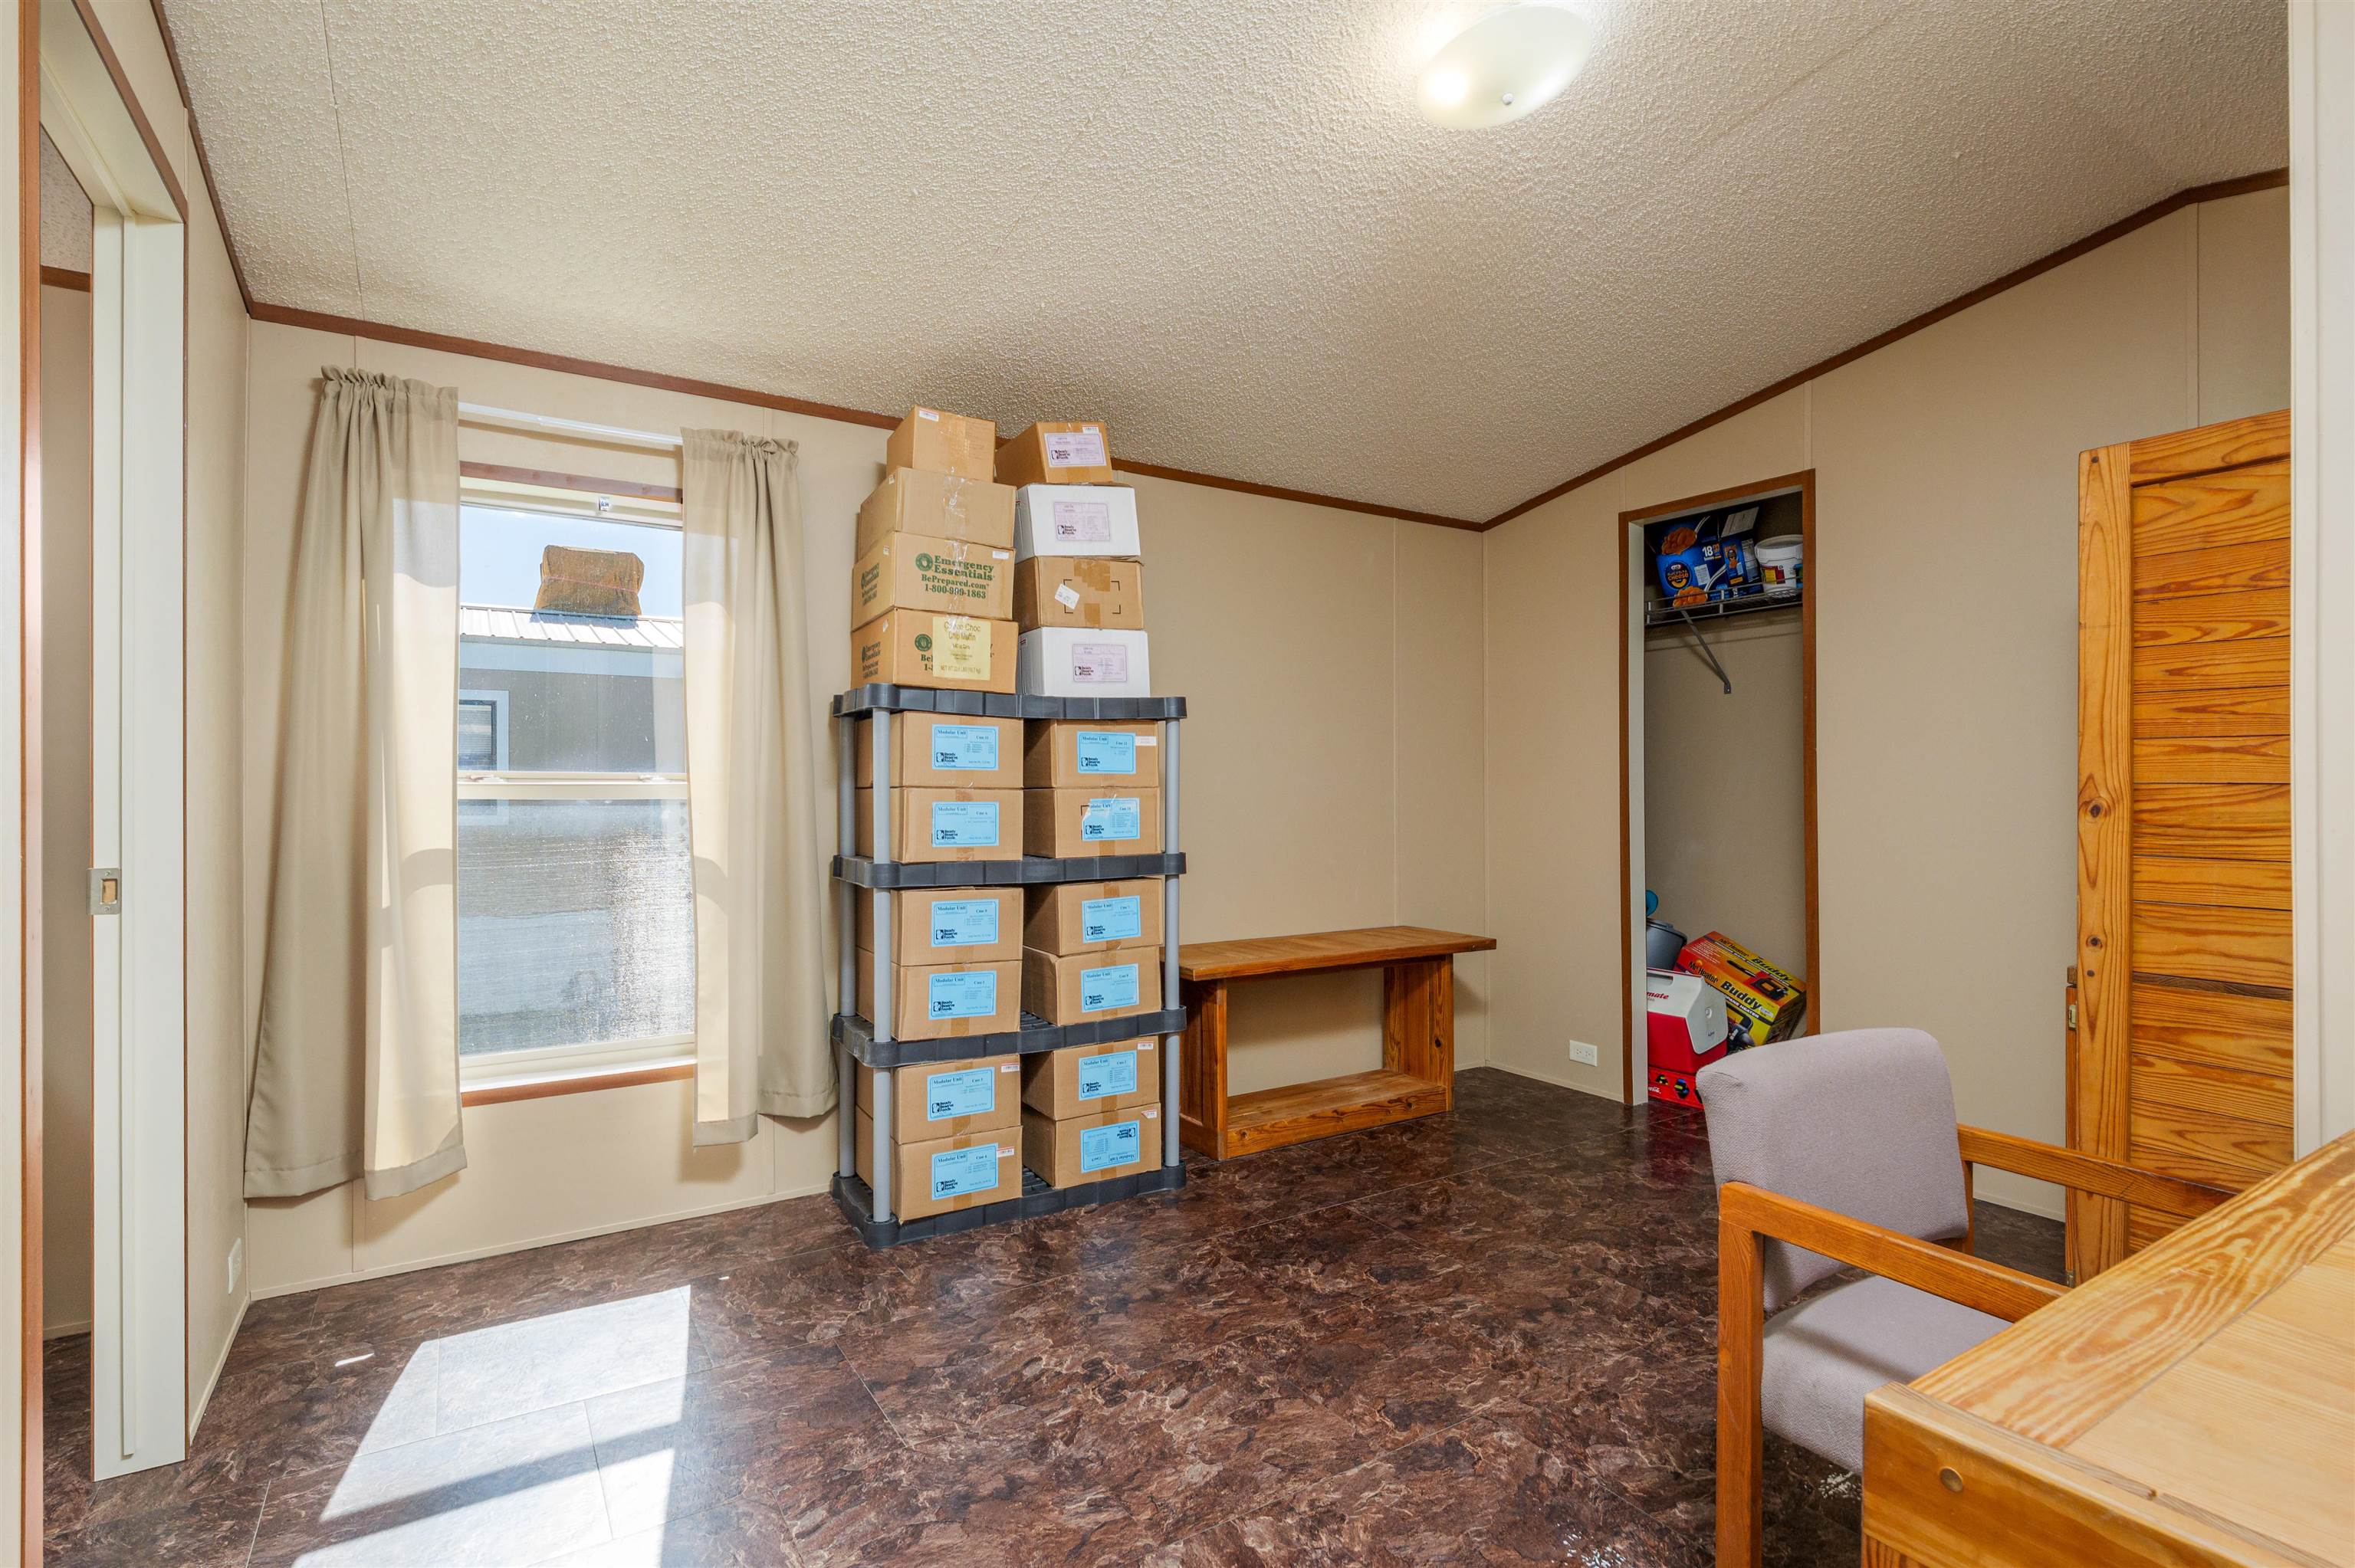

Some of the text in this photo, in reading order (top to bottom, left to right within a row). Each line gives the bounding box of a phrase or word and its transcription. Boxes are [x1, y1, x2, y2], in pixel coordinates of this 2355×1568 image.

[1702, 546, 1713, 556] 18
[934, 555, 994, 573] Emergency
[934, 564, 993, 581] Essentials
[925, 584, 986, 599] 1-800-999-1863
[1699, 967, 1719, 983] Heater
[1751, 957, 1792, 981] Buddy
[1720, 981, 1762, 1009] Buddy
[1739, 1003, 1760, 1019] HEATER
